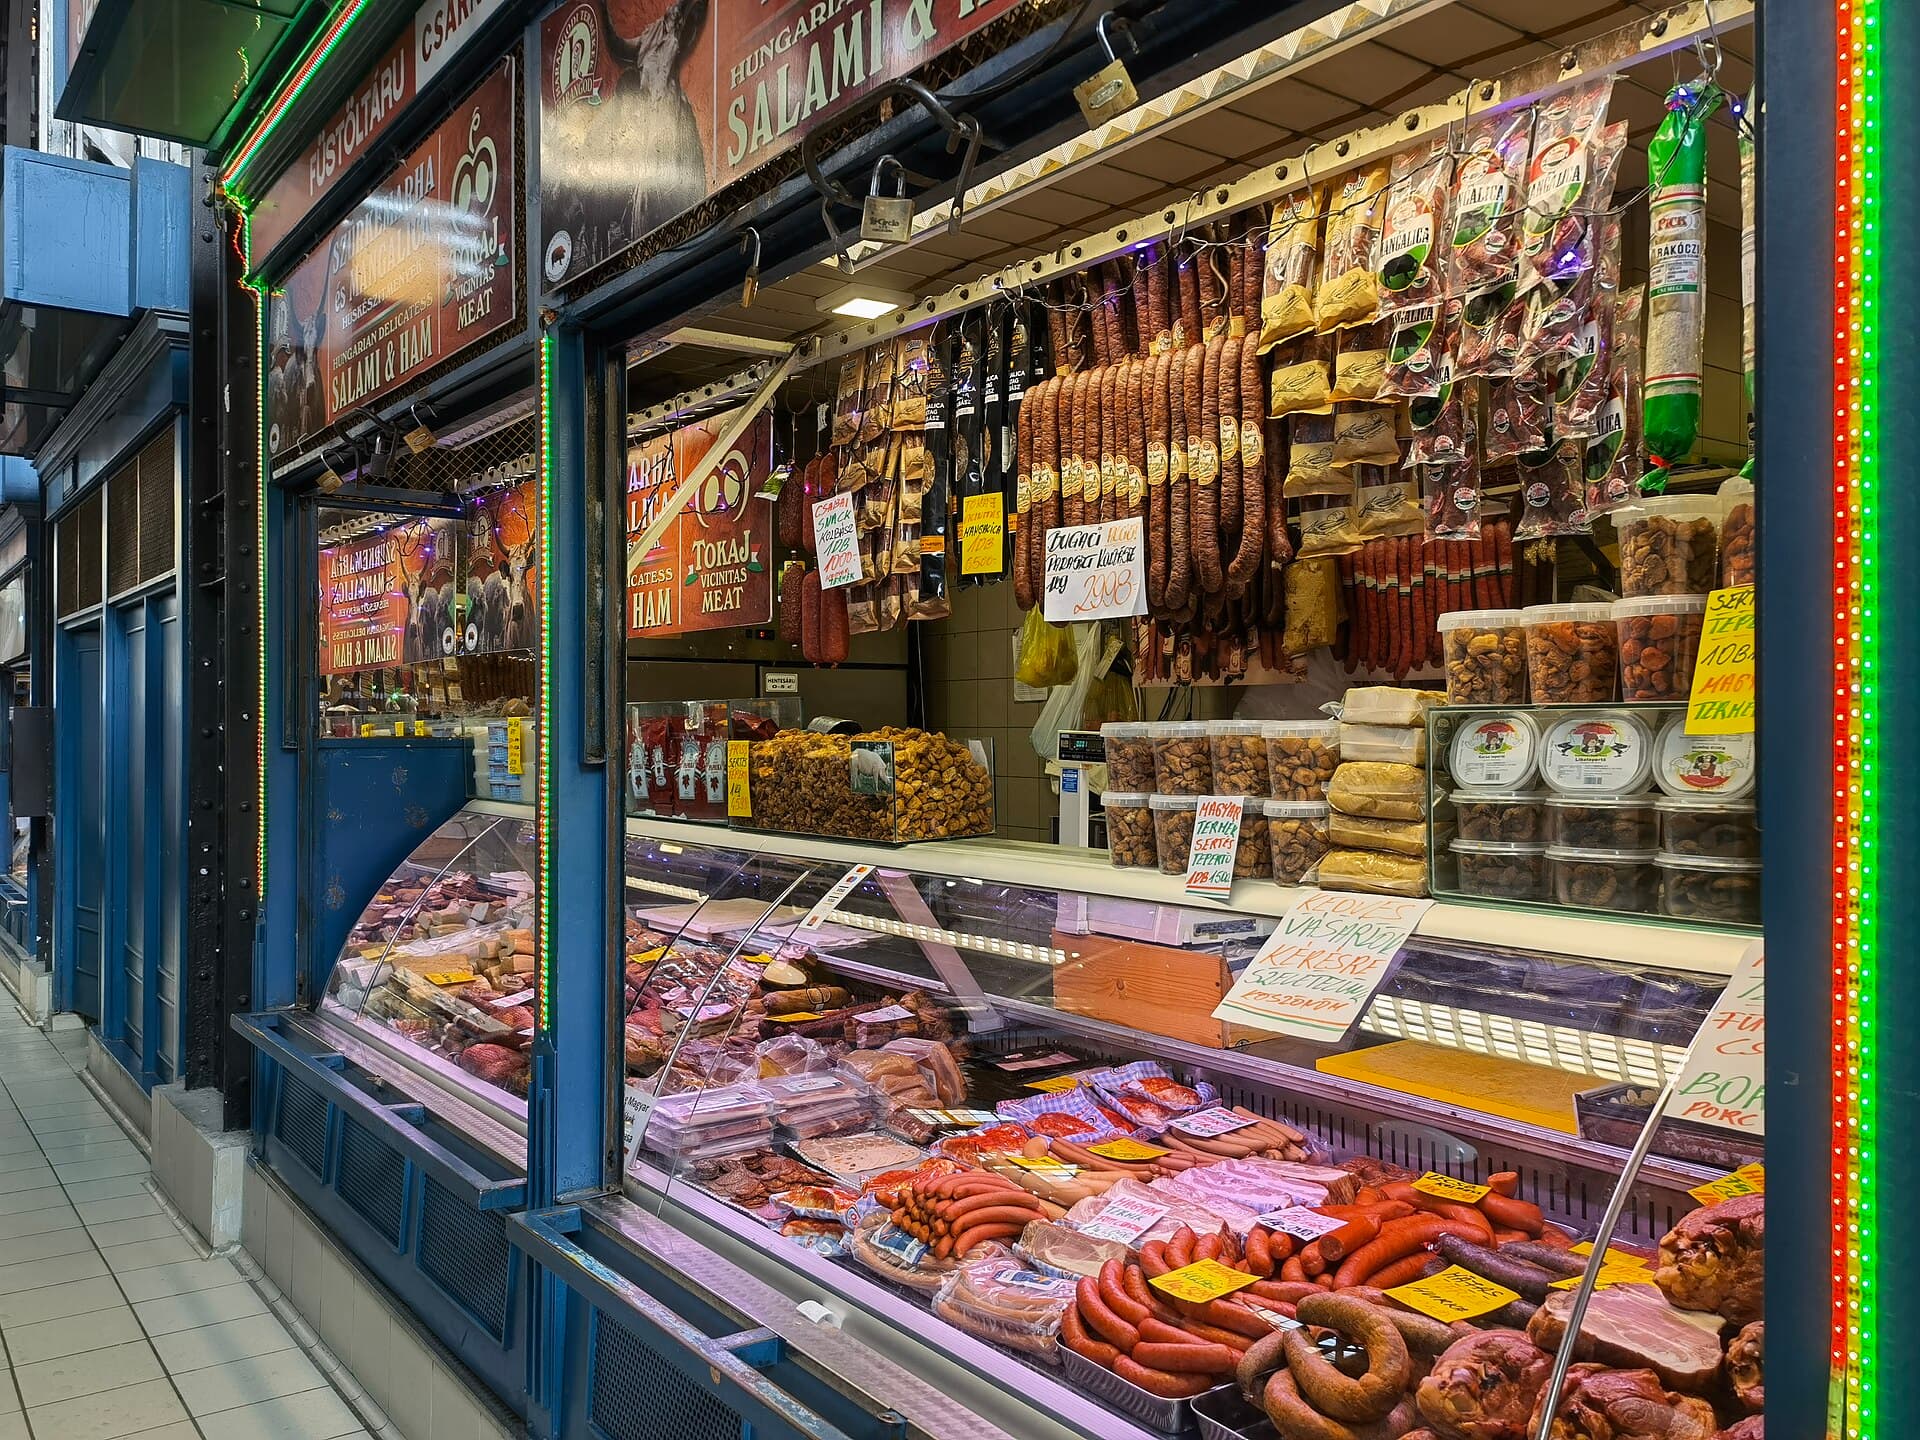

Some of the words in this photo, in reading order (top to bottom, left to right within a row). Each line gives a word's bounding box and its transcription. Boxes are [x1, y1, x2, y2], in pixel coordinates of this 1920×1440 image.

[727, 0, 884, 167] SALAMI
[309, 48, 405, 197] FÜSTÖLTÁRU
[455, 264, 495, 302] VICINITAS
[457, 287, 493, 331] MEAT
[332, 332, 379, 371] HUNGARIAN
[378, 291, 433, 342] DELICATESS
[332, 351, 381, 413] SALAMI
[385, 340, 395, 383] &
[400, 315, 433, 375] HAM
[692, 530, 751, 571] TOKAJ
[701, 567, 747, 588] VICINITAS
[632, 588, 672, 629] HAM
[701, 586, 744, 613] MEAT
